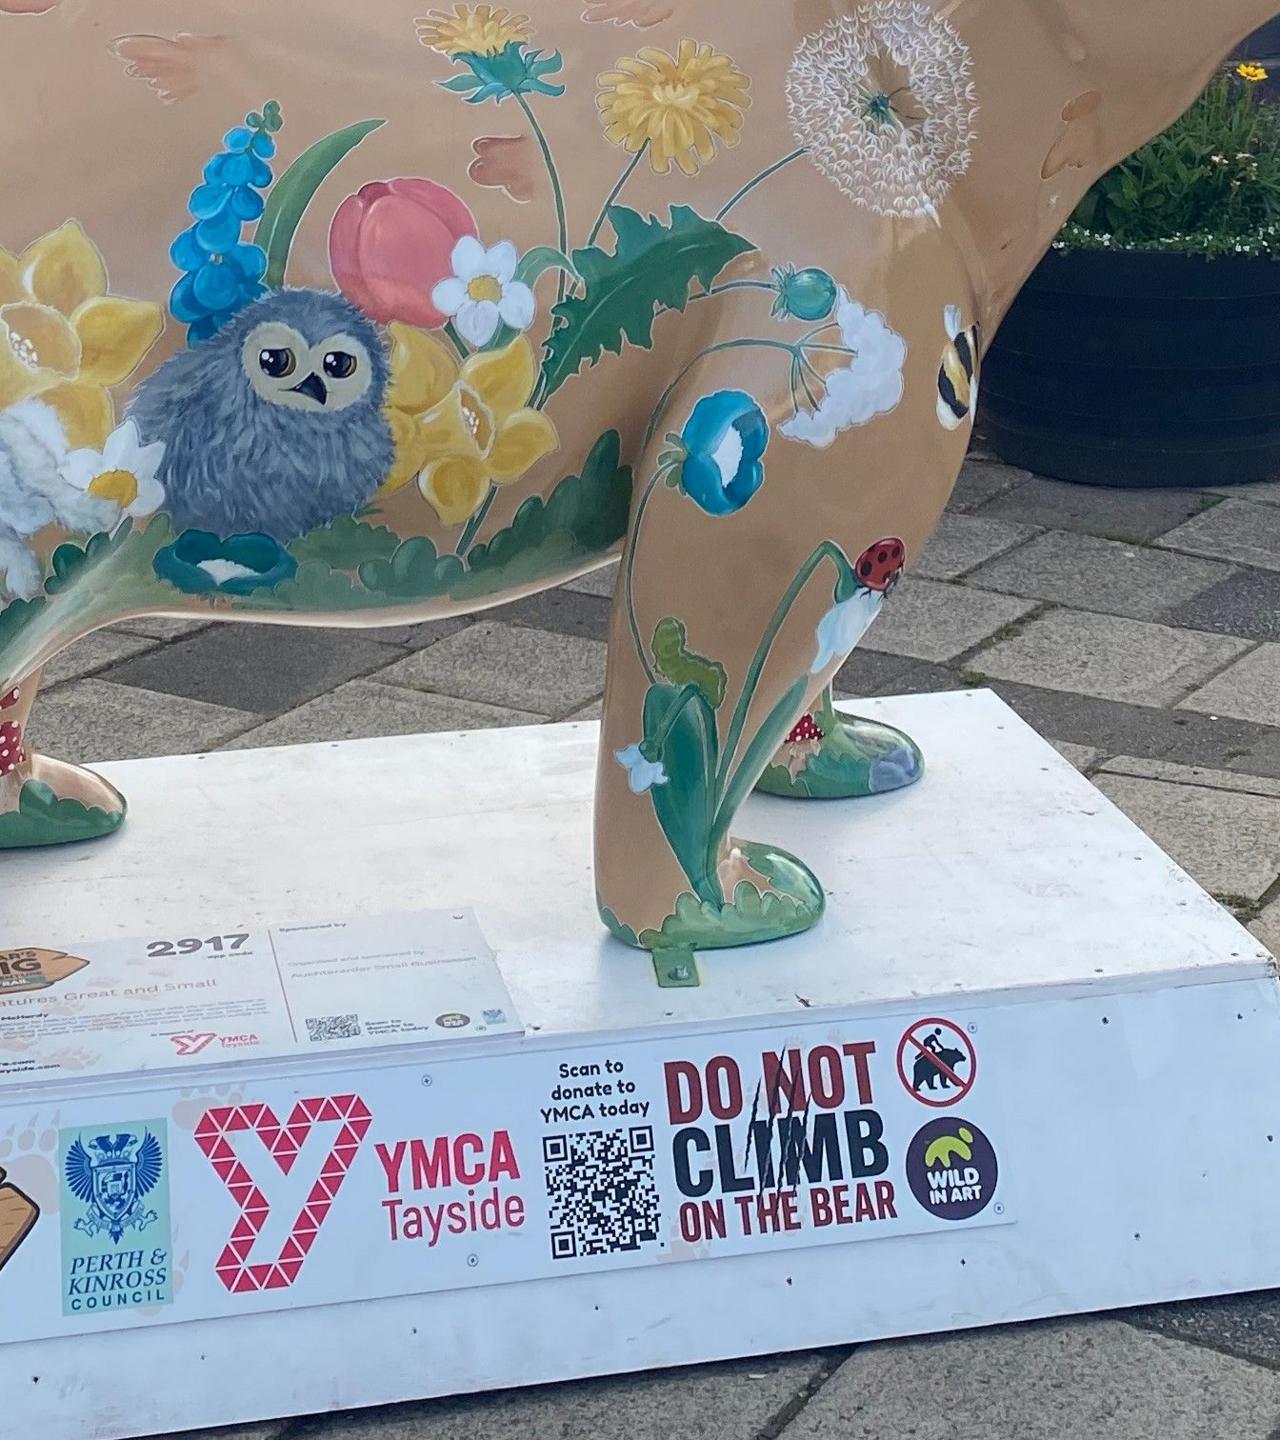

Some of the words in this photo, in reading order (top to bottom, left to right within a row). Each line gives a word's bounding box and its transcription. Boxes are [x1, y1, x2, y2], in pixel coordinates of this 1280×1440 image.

[146, 933, 250, 957] 2917
[64, 988, 117, 1000] Great
[123, 984, 159, 995] and
[164, 979, 218, 991] Small
[219, 1034, 258, 1043] YMCA
[559, 1063, 600, 1078] Scan
[605, 1059, 624, 1074] to
[551, 1082, 612, 1101] donate
[617, 1079, 636, 1094] to
[664, 1055, 743, 1125] DO
[762, 1041, 876, 1114] NOT
[540, 1104, 595, 1124] YMCA
[599, 1099, 650, 1118] today
[374, 1130, 520, 1193] YMCA
[672, 1109, 889, 1198] CLIMB
[927, 1167, 979, 1190] WILD
[929, 1189, 947, 1205] IN
[951, 1185, 982, 1202] ART
[381, 1187, 525, 1247] Tayside
[679, 1198, 727, 1243] ON
[734, 1191, 802, 1236] THE
[810, 1180, 898, 1228] BEAR
[70, 1250, 144, 1275] PERTH
[150, 1248, 167, 1265] &
[68, 1267, 167, 1296] KINROSS
[71, 1289, 165, 1310] COUNCIL
